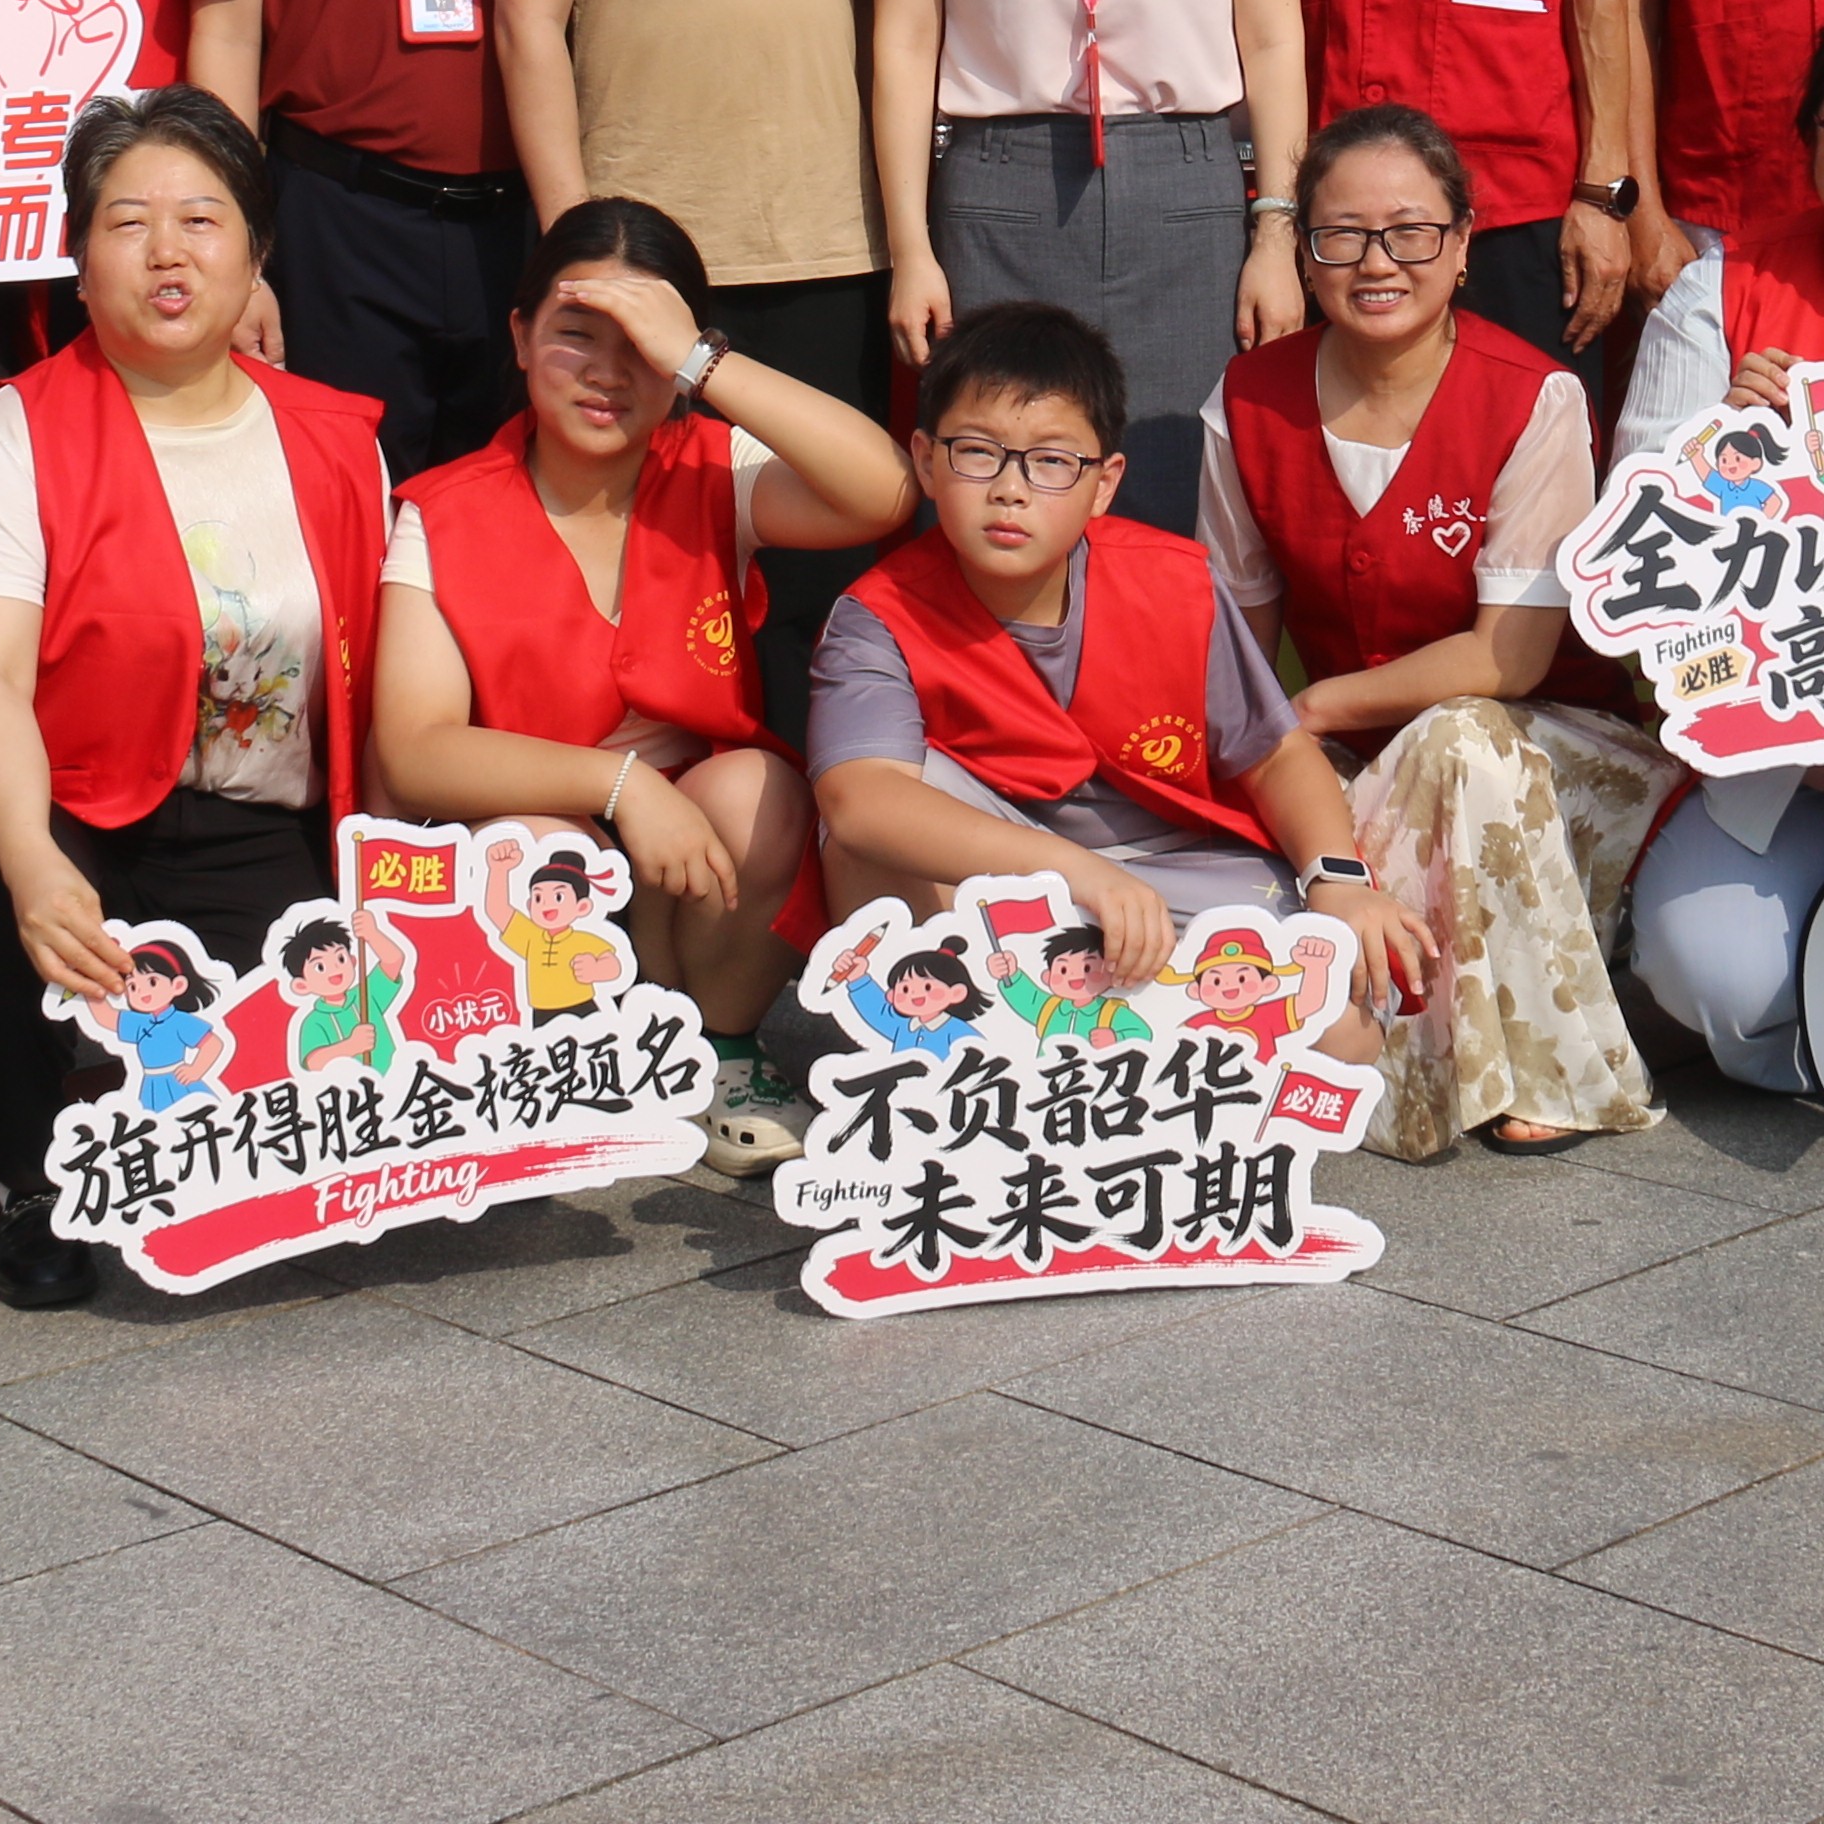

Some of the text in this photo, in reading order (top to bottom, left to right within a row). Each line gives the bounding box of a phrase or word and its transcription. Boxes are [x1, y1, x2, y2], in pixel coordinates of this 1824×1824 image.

[1402, 494, 1486, 535] 茶陵义
[1655, 622, 1736, 665] Fighting
[1679, 648, 1740, 696] 必胜
[369, 851, 448, 895] 必胜
[428, 996, 508, 1035] 小状元
[64, 1012, 702, 1227] 旗开得胜金榜题名
[827, 1037, 1262, 1162] 不负韶华
[1281, 1085, 1344, 1123] 必胜
[313, 1156, 491, 1227] Fighting
[796, 1179, 892, 1216] Fighting
[882, 1141, 1297, 1273] 未来可期
